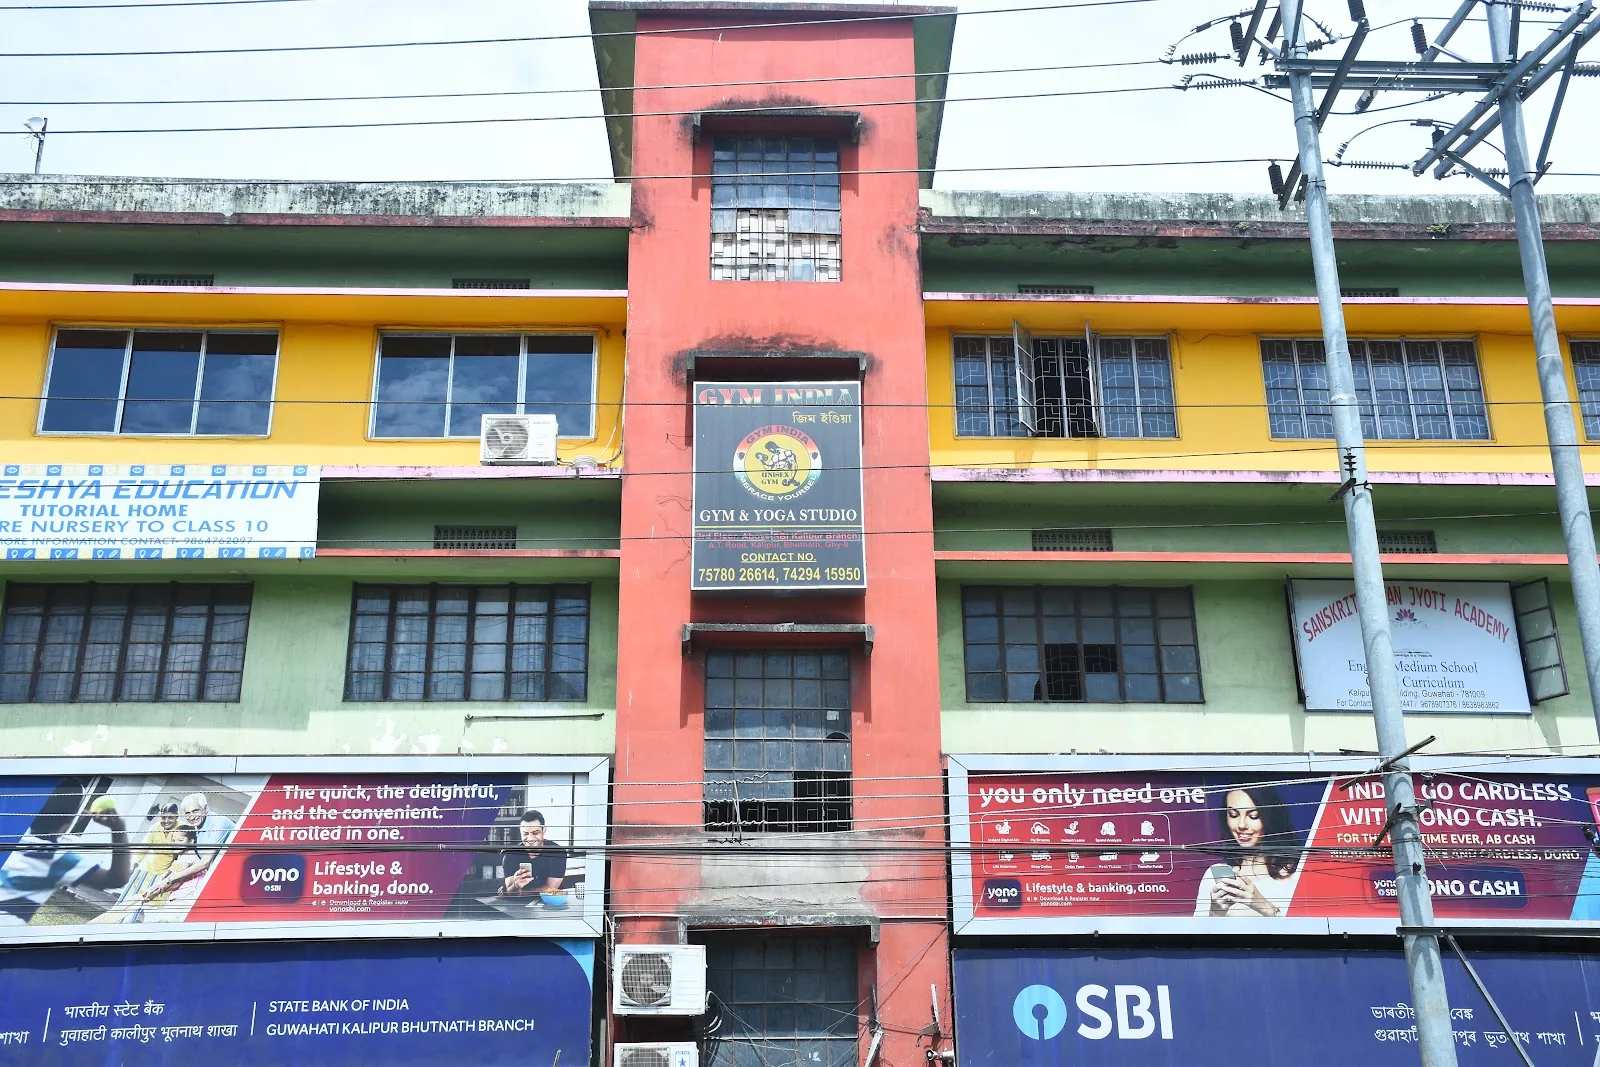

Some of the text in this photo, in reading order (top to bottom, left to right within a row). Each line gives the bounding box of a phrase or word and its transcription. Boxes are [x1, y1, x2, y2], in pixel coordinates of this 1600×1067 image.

[699, 388, 854, 408] GYM INDIA
[792, 411, 816, 424] জিম
[746, 425, 809, 445] GYM INDIA
[113, 479, 299, 500] EDUCATION
[739, 474, 817, 502] MBRACE YOURSEL
[20, 504, 188, 517] TUTORIAL HOME
[699, 509, 857, 521] GYM & YOGA STUDIO
[31, 520, 129, 533] NURSERY
[138, 520, 164, 533] TO
[172, 520, 236, 533] CLASS
[246, 520, 269, 533] 10
[32, 537, 118, 546] INFORMATION
[741, 553, 817, 562] CONTACT NO.
[698, 567, 860, 583] 75780 26614, 74294 15950
[1303, 593, 1360, 643] SANSKRIT
[1408, 587, 1447, 613] JYOTI
[1455, 598, 1509, 643] ACADEMY
[1441, 661, 1478, 673] School
[1402, 677, 1465, 689] Curriculum
[1348, 689, 1371, 698] Kalipu
[1421, 690, 1455, 699] Guwahati
[1336, 699, 1347, 707] For
[283, 784, 499, 803] The quick, the delightful,
[979, 783, 1205, 808] you only need one
[1348, 781, 1572, 801] IND GO CARDLESS
[271, 805, 444, 821] and the convenient.
[1340, 807, 1542, 827] WIT ONO CASH.
[260, 826, 405, 841] All rolled in one.
[1337, 833, 1360, 843] FOR
[1422, 834, 1448, 844] TIME
[1451, 834, 1483, 846] EVER,
[1486, 834, 1502, 844] AB
[1504, 834, 1536, 844] CASH
[250, 868, 300, 887] yono
[314, 860, 403, 879] Lifestyle &
[312, 880, 434, 898] banking, dono.
[987, 887, 1018, 899] yono
[1026, 882, 1170, 895] Lifestyle & banking, dono.
[1469, 880, 1520, 895] CASH
[64, 998, 165, 1018] भारतीय स्टेट बैंक
[268, 998, 409, 1014] STATE BANK OF INDIA
[1075, 985, 1173, 1039] SBI
[60, 1021, 238, 1046] गुवाहाटी कालीपुर भूतनाथ शाखा
[266, 1018, 535, 1036] GUWAHATI KALIPUR BHUTNATH BRANCH
[1536, 1032, 1566, 1046] শাখা
